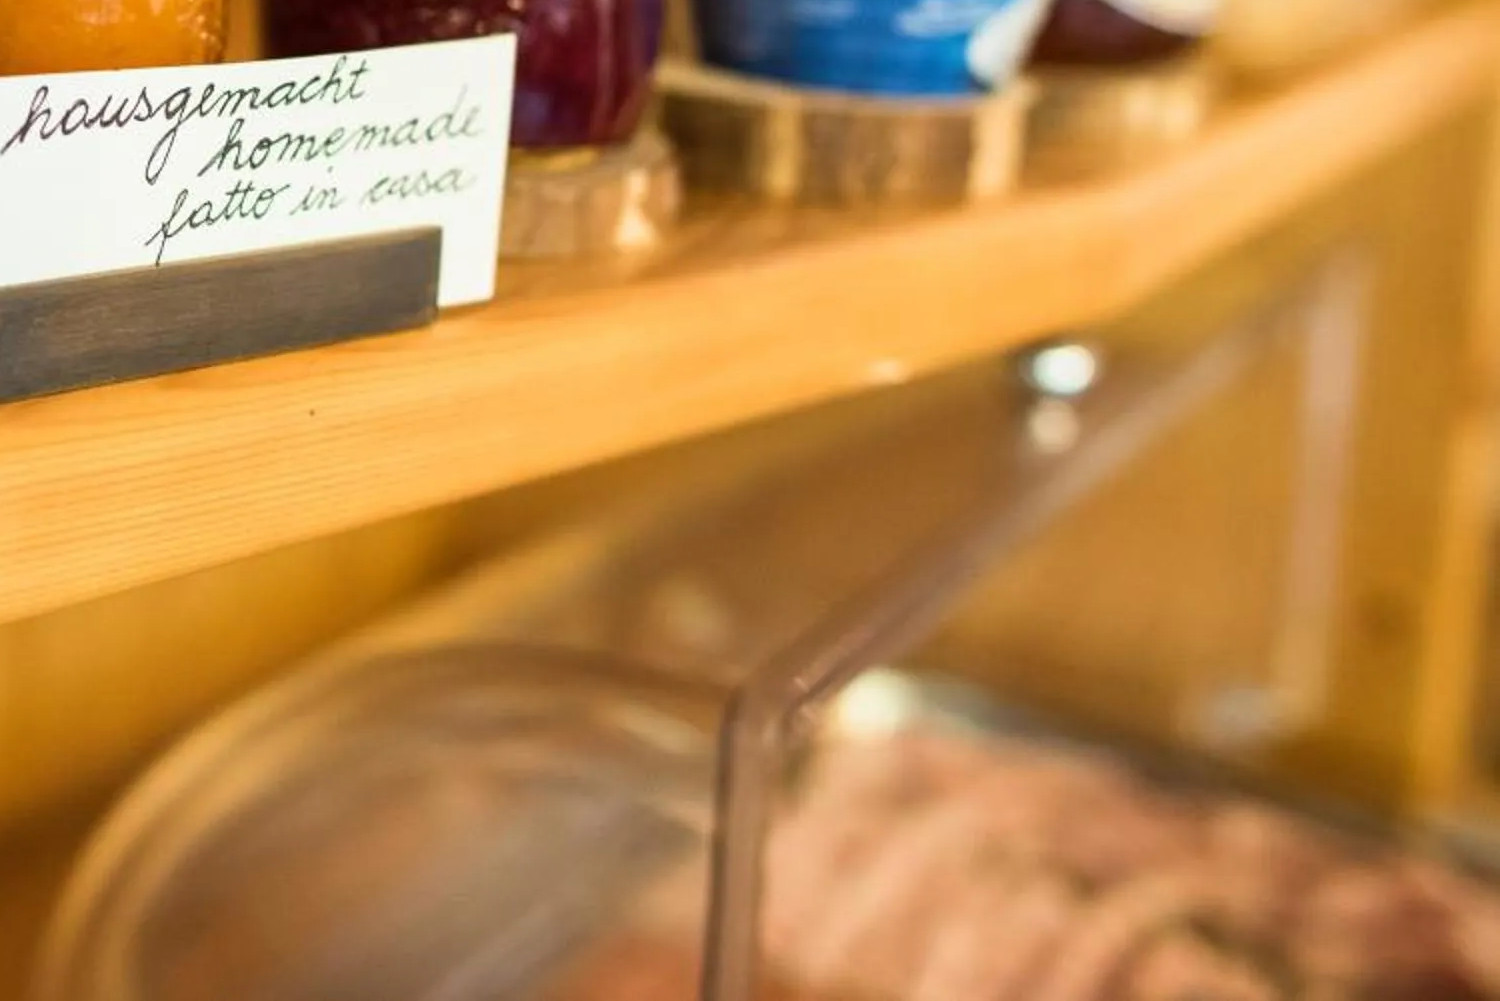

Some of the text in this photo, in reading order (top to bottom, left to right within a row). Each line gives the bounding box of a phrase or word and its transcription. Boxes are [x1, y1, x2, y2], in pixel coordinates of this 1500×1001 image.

[0, 55, 370, 185] hausgemacht
[197, 85, 482, 178] homemade
[144, 165, 474, 267] fatto in casa
